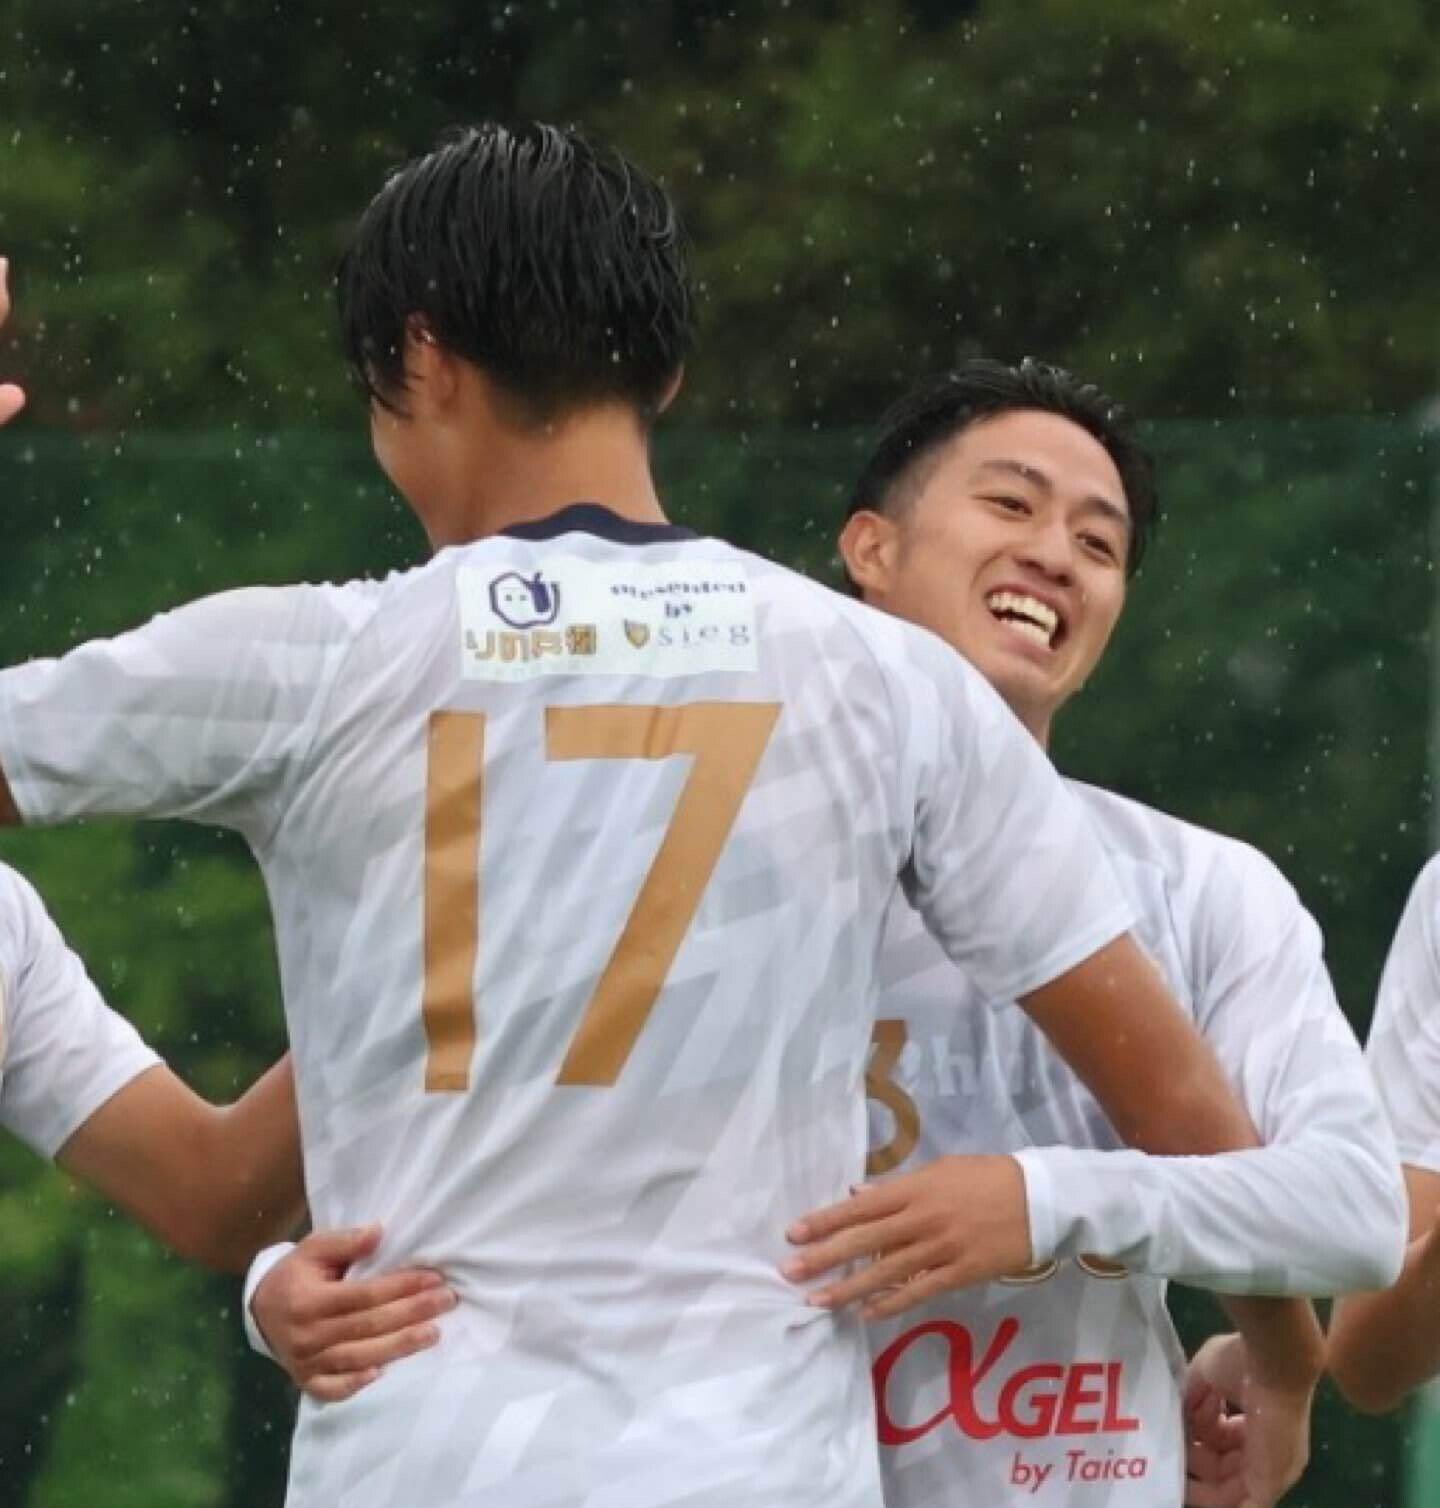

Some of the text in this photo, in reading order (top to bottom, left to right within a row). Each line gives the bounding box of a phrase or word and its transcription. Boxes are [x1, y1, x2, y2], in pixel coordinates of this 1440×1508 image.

[422, 701, 783, 1093] 17
[1010, 1449, 1148, 1493] by Taica
